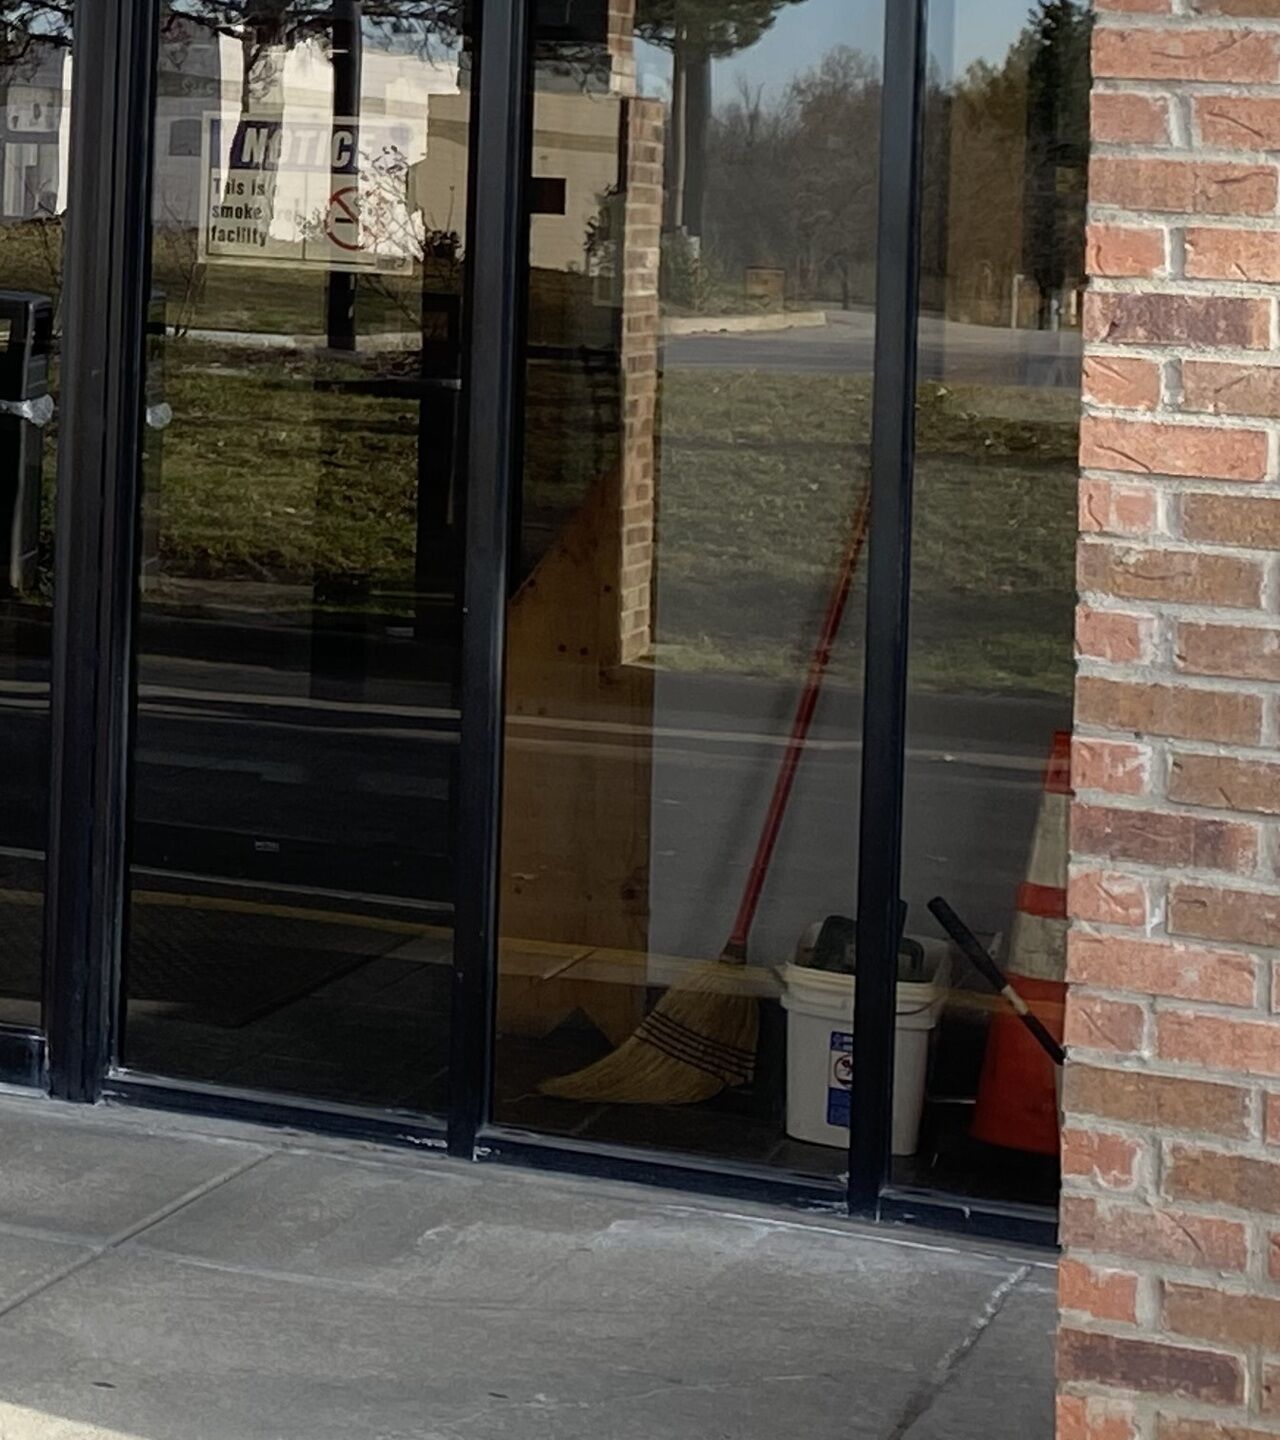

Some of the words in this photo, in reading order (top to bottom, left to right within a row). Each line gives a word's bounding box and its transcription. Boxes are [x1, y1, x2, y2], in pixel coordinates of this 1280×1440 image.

[251, 178, 265, 195] is
[211, 202, 263, 220] smoke
[210, 224, 267, 247] facility
